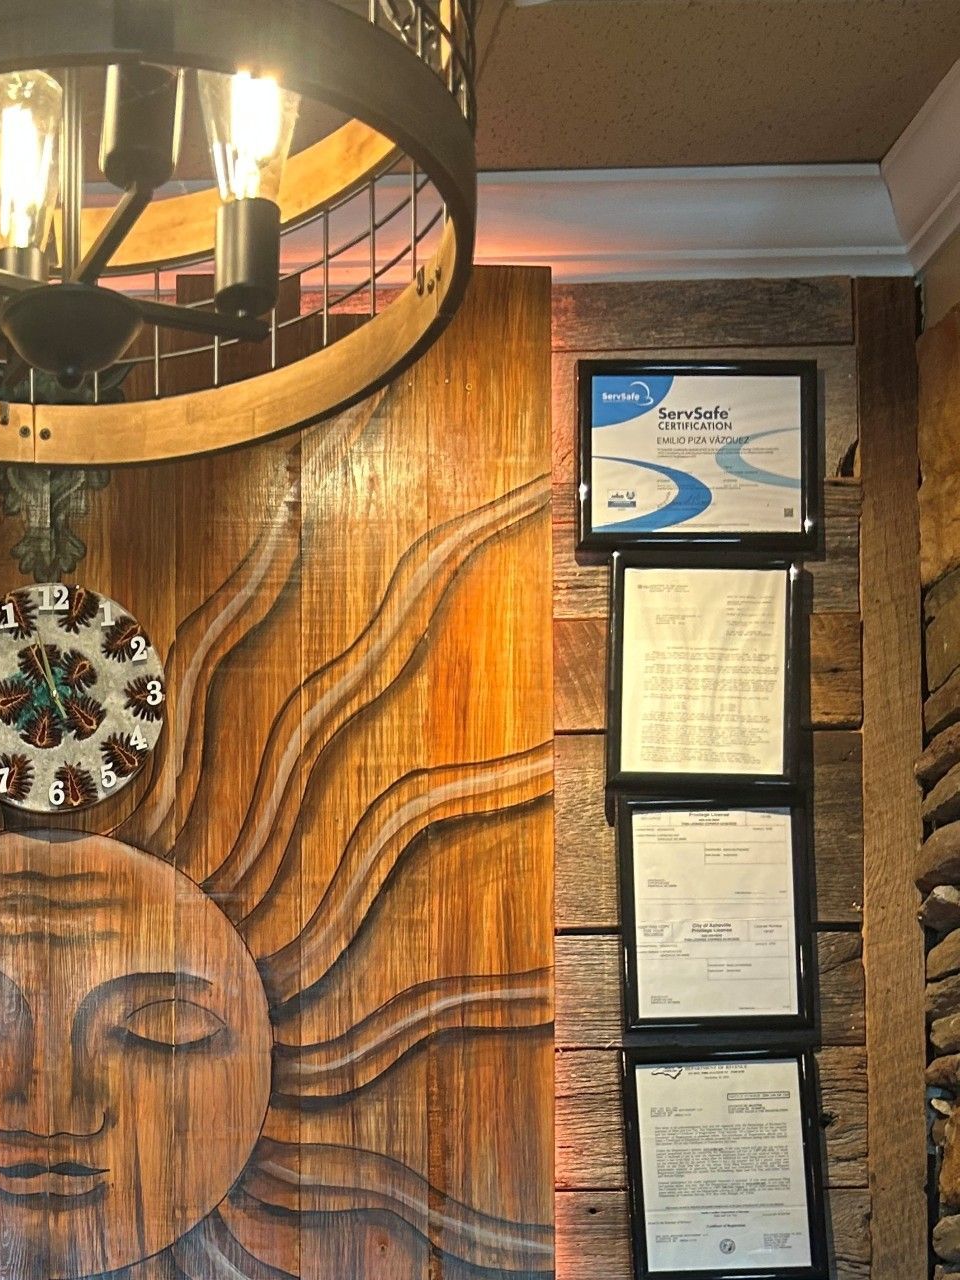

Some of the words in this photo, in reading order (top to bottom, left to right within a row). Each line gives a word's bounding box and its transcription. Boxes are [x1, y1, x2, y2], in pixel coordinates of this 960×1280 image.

[602, 392, 640, 401] ServSafe
[658, 421, 733, 431] CERTIFICATION
[657, 436, 686, 445] EMILIO
[687, 436, 707, 445] PIZA
[38, 585, 69, 611] 12
[99, 601, 115, 627] 1
[130, 636, 147, 661] 2
[146, 680, 163, 706] 3
[130, 726, 148, 750] 4
[101, 763, 117, 788] 5
[49, 781, 65, 805] 6
